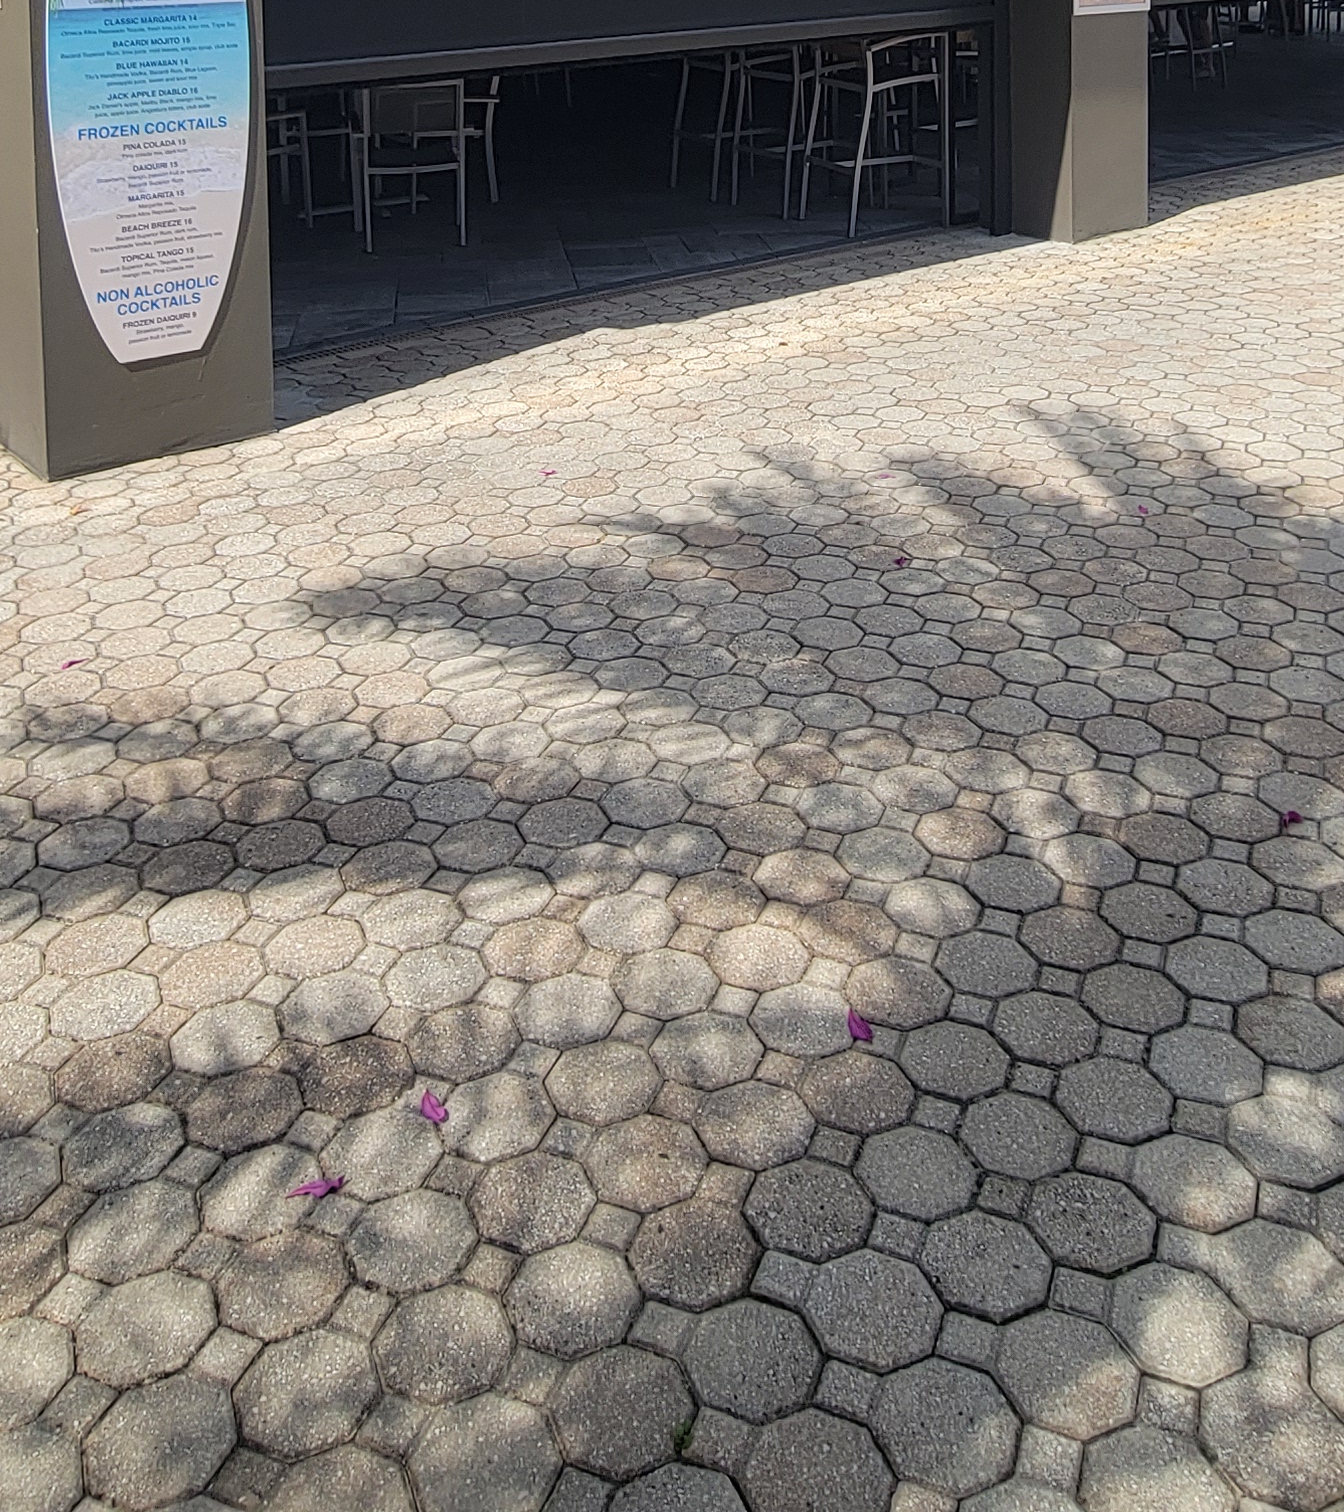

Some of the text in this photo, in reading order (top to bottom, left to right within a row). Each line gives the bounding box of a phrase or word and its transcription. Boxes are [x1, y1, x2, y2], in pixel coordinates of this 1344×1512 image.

[104, 18, 139, 26] CLASSIC
[140, 15, 187, 25] MARGARITA
[112, 38, 149, 48] BACARDI
[151, 37, 180, 46] MOJITO
[116, 61, 137, 70] BLUE
[180, 58, 188, 66] 14
[107, 92, 129, 101] JACK
[131, 90, 156, 99] APPLE
[158, 88, 188, 97] DIABLO
[77, 115, 228, 141] FROZEN COCKTAILS
[143, 140, 176, 149] COLADA
[132, 162, 168, 172] DAIQUIRI
[128, 191, 174, 203] MARGARITA
[121, 222, 150, 233] BEACH
[151, 219, 182, 230] BREEZE
[120, 253, 155, 264] TOPICAL
[156, 248, 184, 259] TANGO
[96, 274, 220, 304] NON ALCOHOLIC
[117, 292, 202, 316] COCKTAILS
[122, 318, 155, 330] FROZEN
[156, 311, 191, 324] DAIQUIRI
